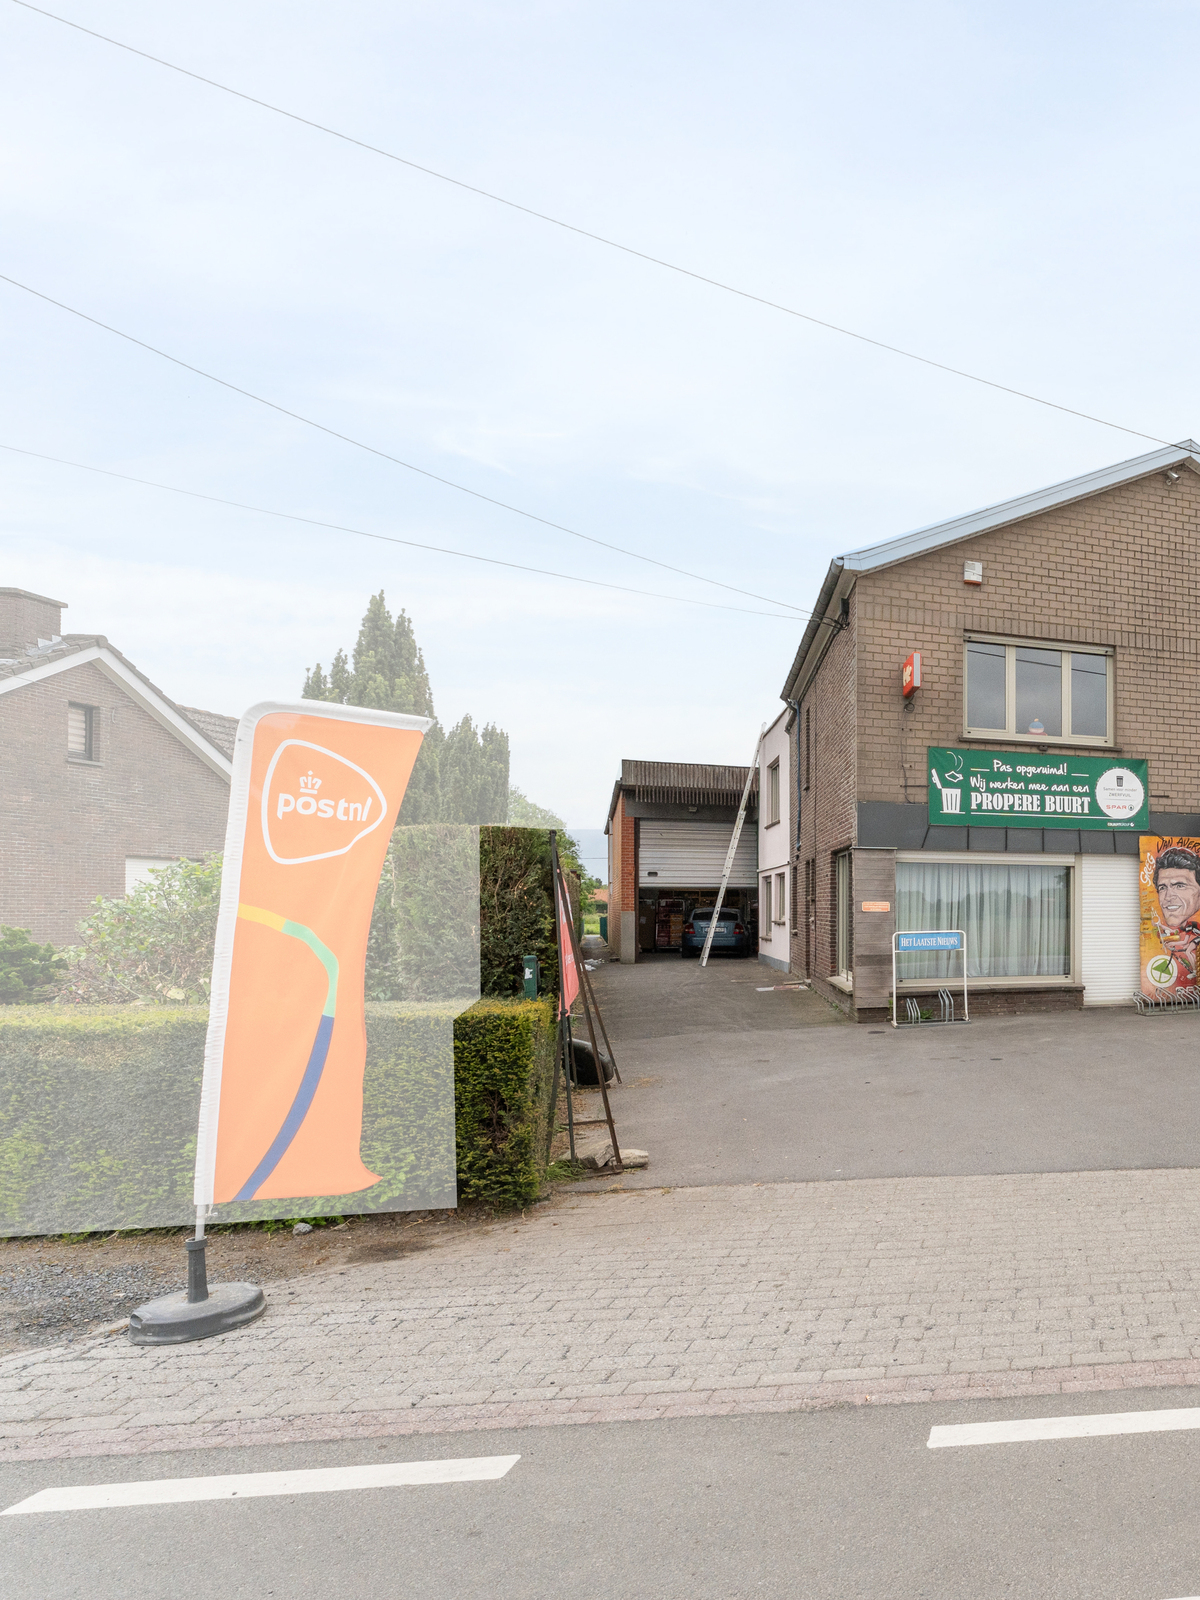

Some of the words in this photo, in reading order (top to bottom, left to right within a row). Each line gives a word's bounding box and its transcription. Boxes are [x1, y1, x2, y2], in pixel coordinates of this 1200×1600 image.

[993, 759, 1013, 772] Pas
[1016, 763, 1067, 777] opgeruimd!
[970, 774, 986, 792] Wij
[989, 777, 1025, 790] werken
[1028, 783, 1049, 791] mee
[1051, 784, 1070, 792] aan
[1072, 785, 1090, 793] een
[970, 792, 1041, 812] PROPERE
[1044, 795, 1091, 814] BUURT
[1156, 837, 1173, 853] VAN
[1140, 852, 1156, 886] GREG
[901, 937, 912, 947] HET
[913, 937, 936, 946] LAATSTE
[937, 936, 958, 946] NIEUWS
